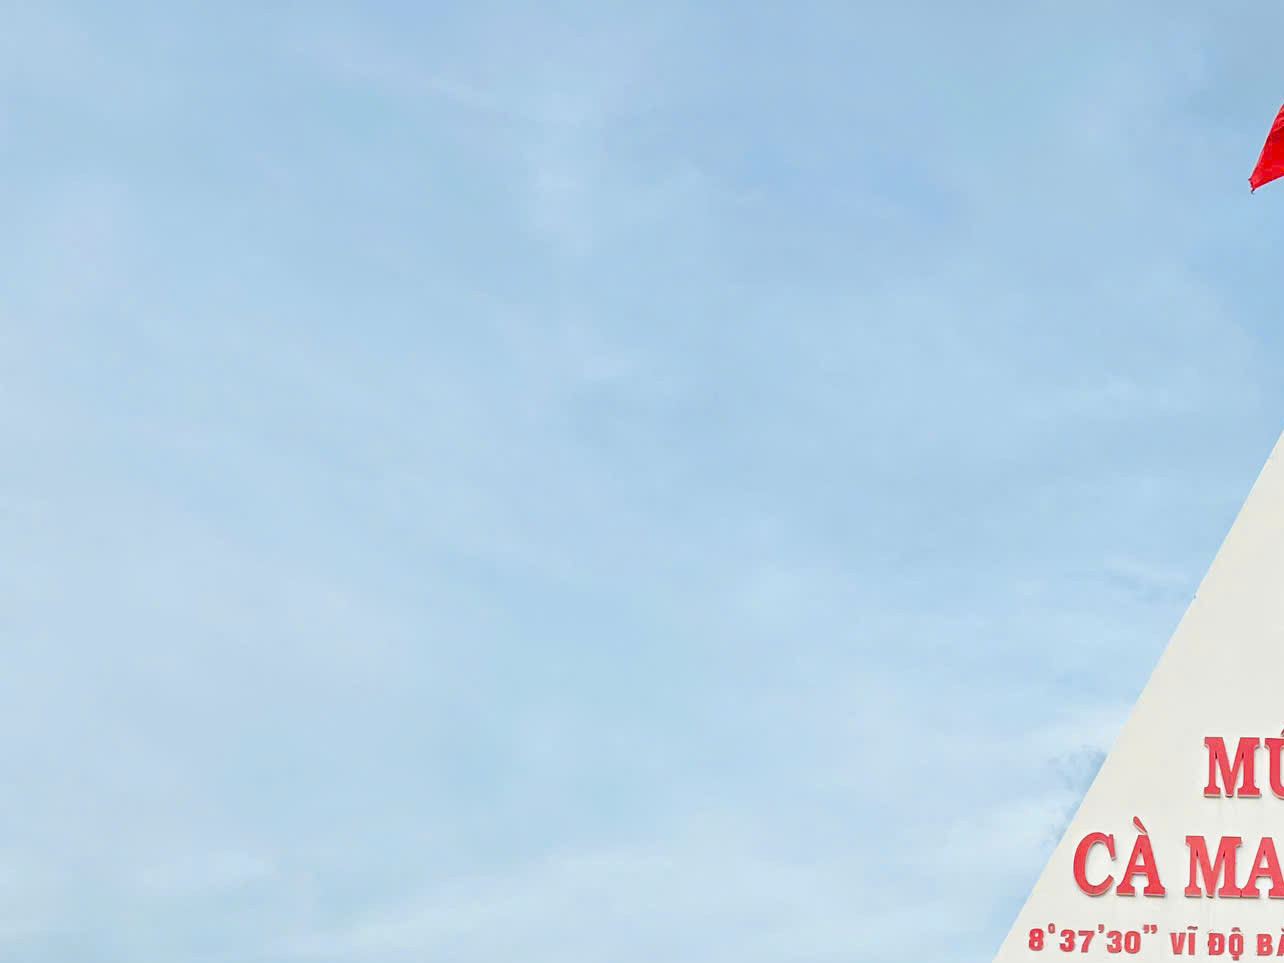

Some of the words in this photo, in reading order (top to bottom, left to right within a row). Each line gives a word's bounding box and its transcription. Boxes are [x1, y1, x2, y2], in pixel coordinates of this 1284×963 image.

[1073, 816, 1166, 898] CÀ
[1170, 926, 1199, 956] VĨ
[1207, 927, 1244, 961] ĐỘ
